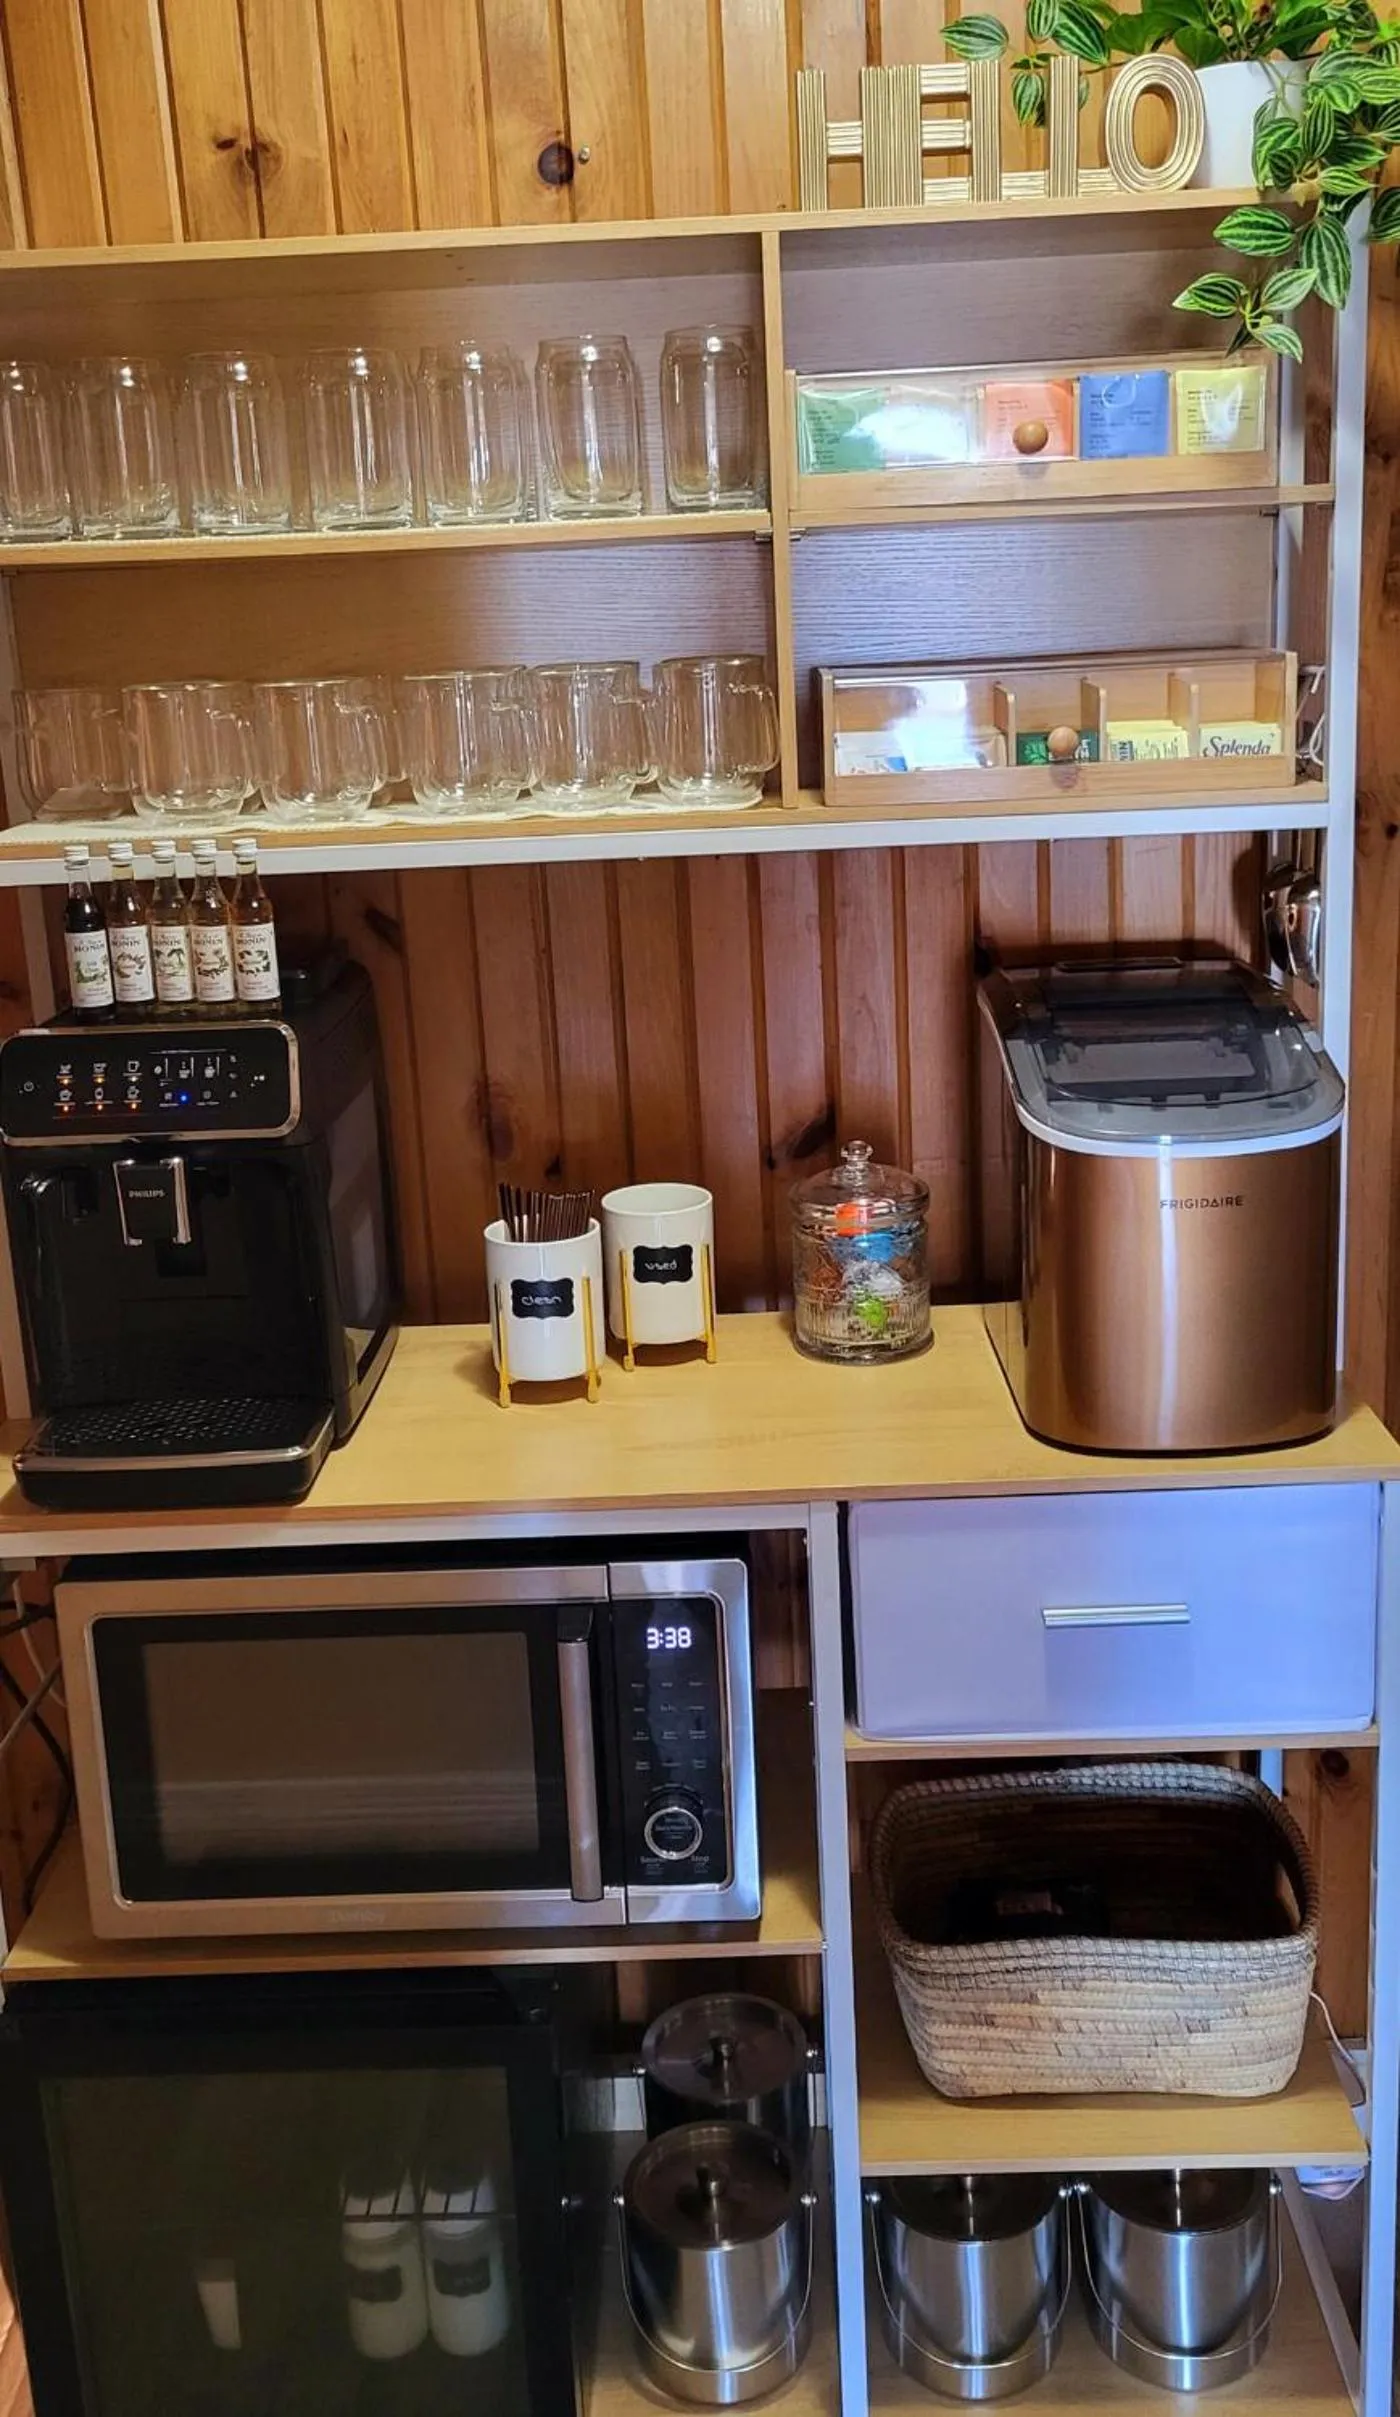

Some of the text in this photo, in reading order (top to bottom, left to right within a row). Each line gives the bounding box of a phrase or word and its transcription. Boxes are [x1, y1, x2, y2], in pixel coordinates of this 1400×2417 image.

[797, 53, 1205, 212] HELLO
[1203, 735, 1271, 757] Splenda
[128, 1189, 165, 1198] PHILIPS
[1160, 1195, 1245, 1209] FRIGIDAIRE
[647, 1626, 692, 1649] 3:38
